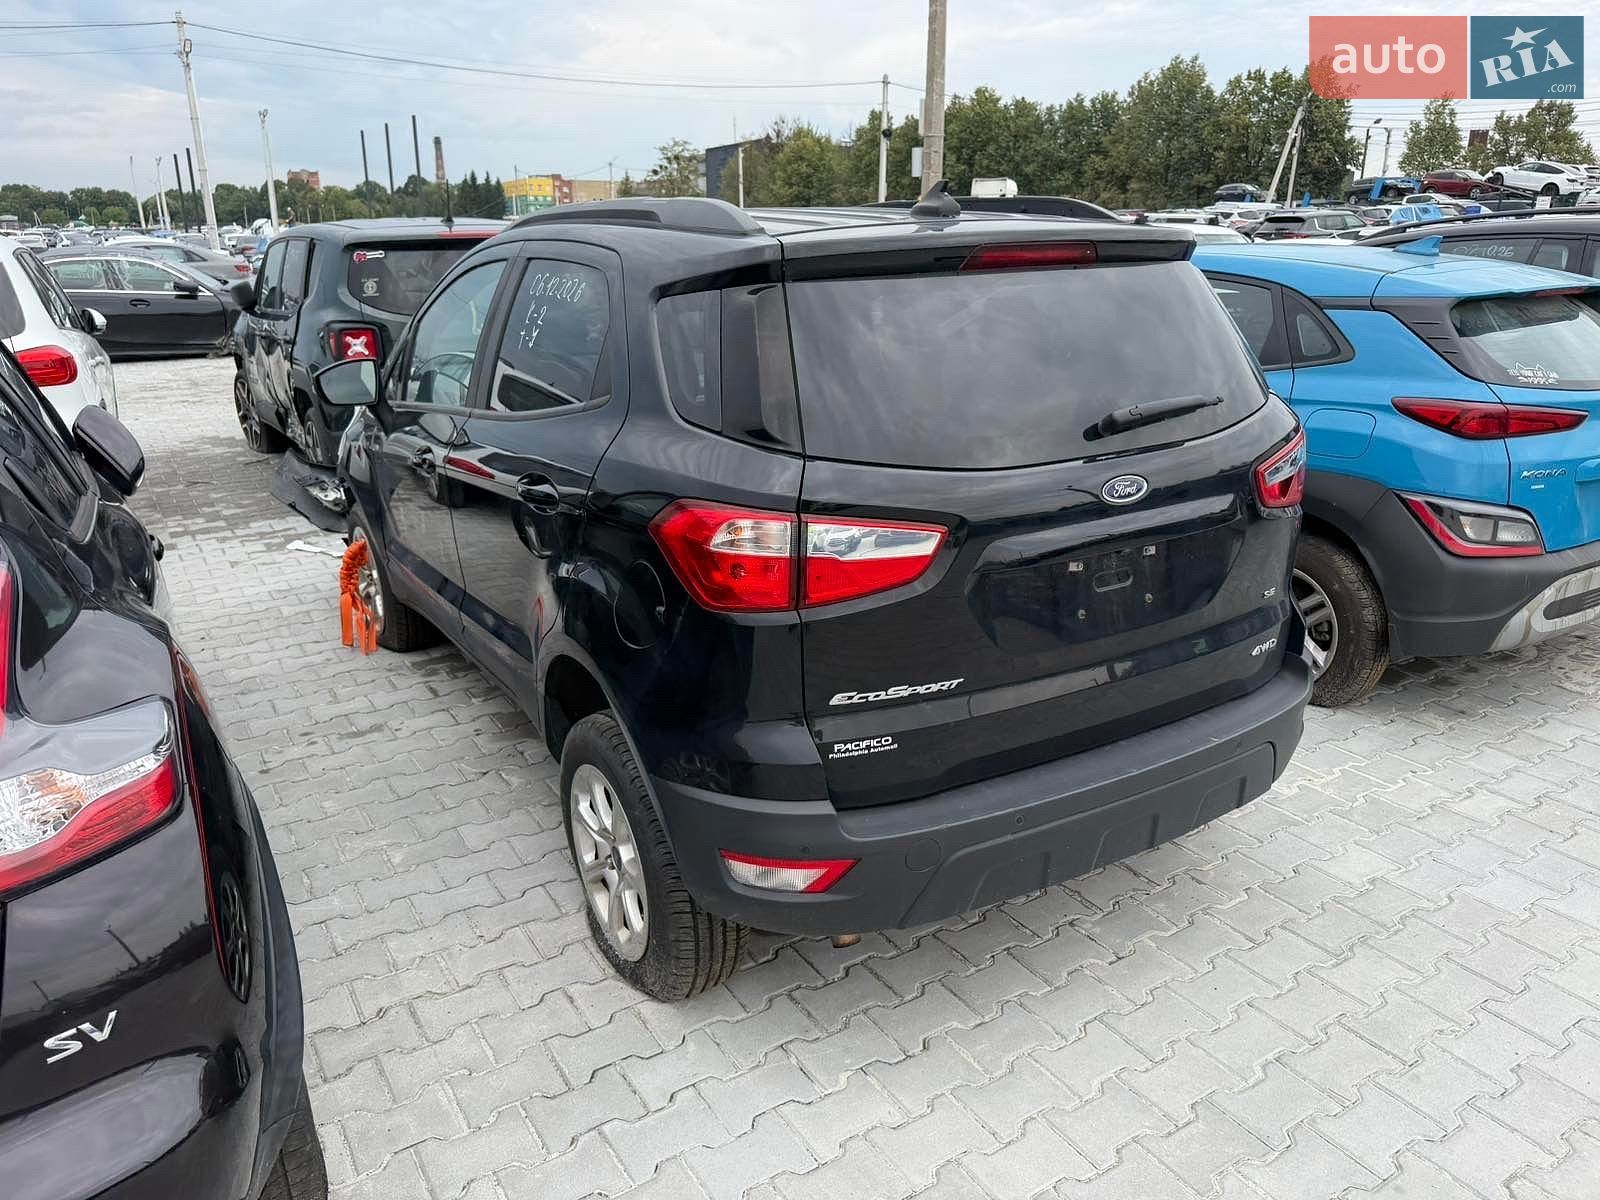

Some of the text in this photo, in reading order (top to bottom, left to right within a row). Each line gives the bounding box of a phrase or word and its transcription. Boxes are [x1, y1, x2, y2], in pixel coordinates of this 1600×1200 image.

[834, 736, 892, 753] PACIFICO
[828, 748, 869, 760] Philadelphia
[43, 1009, 118, 1065] SV
